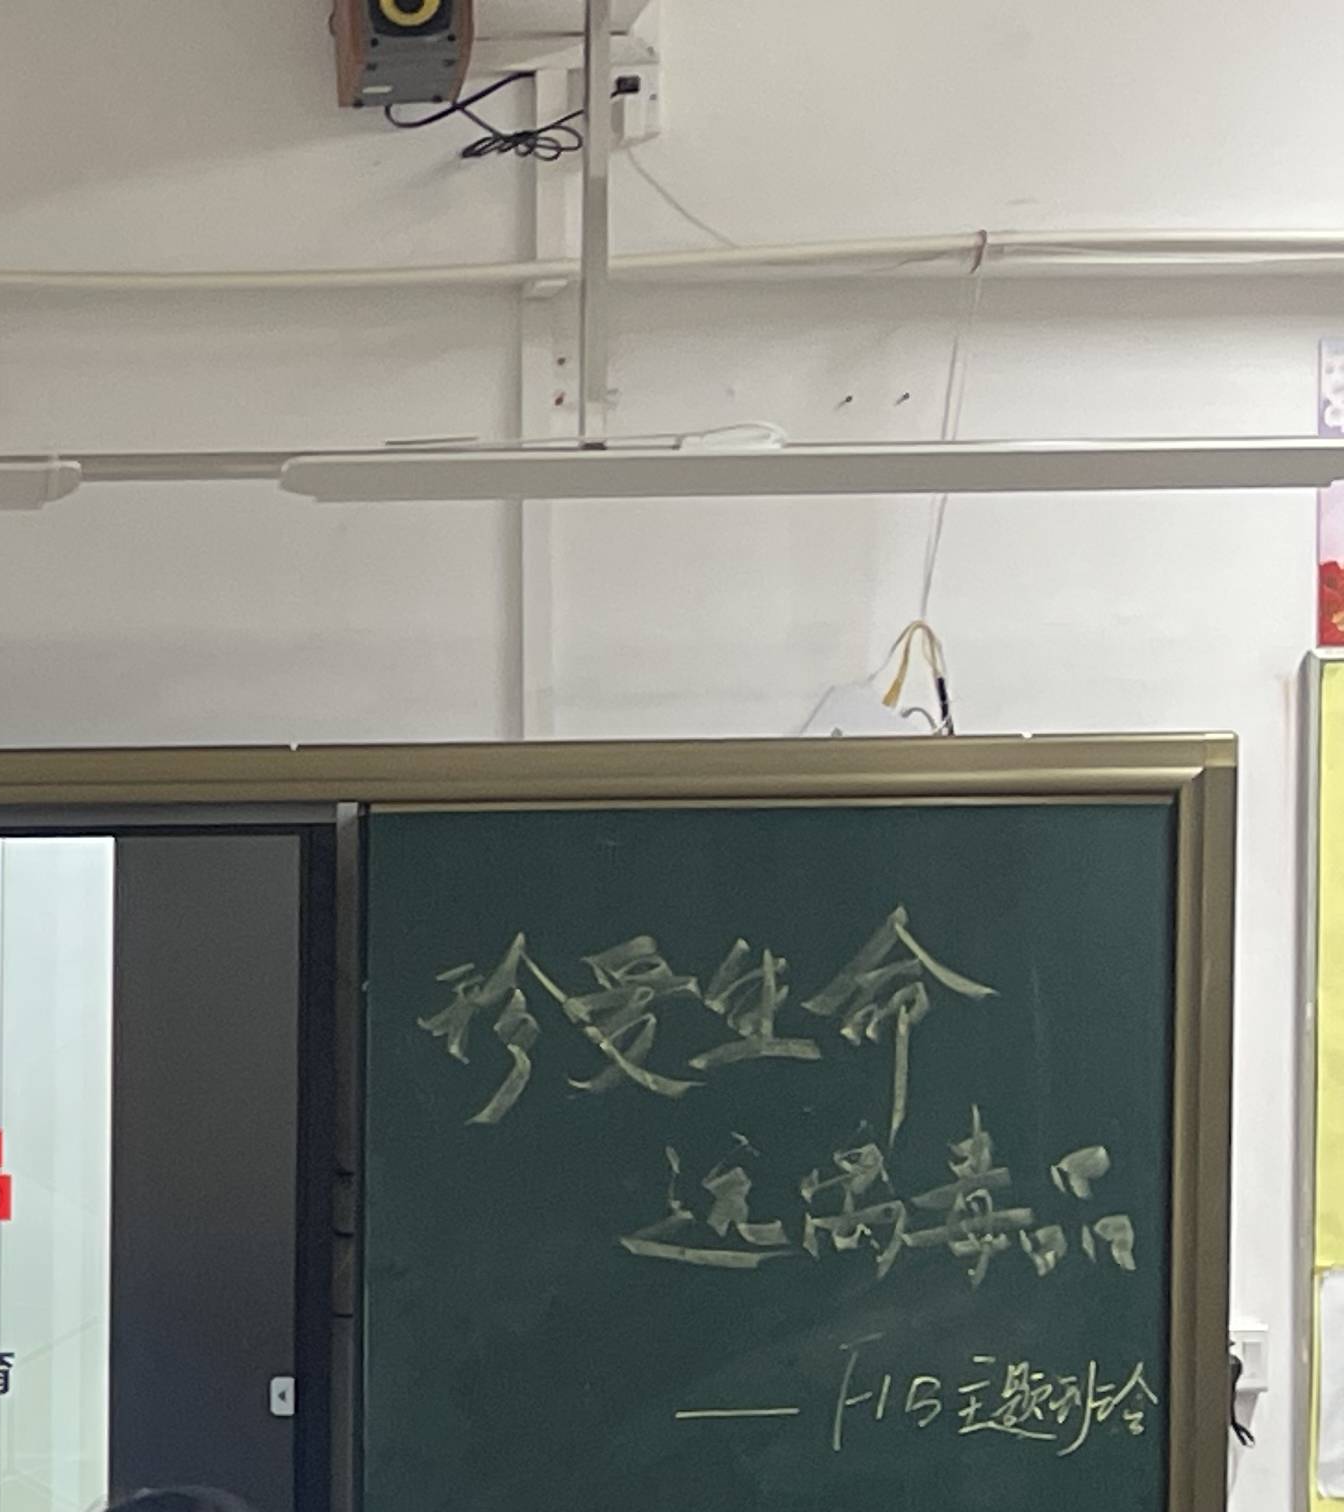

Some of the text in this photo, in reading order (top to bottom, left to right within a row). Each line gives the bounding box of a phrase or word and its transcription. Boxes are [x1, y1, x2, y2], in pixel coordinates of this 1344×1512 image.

[417, 906, 1000, 1148] 珍爱生命
[620, 1104, 1137, 1282] 远离毒品
